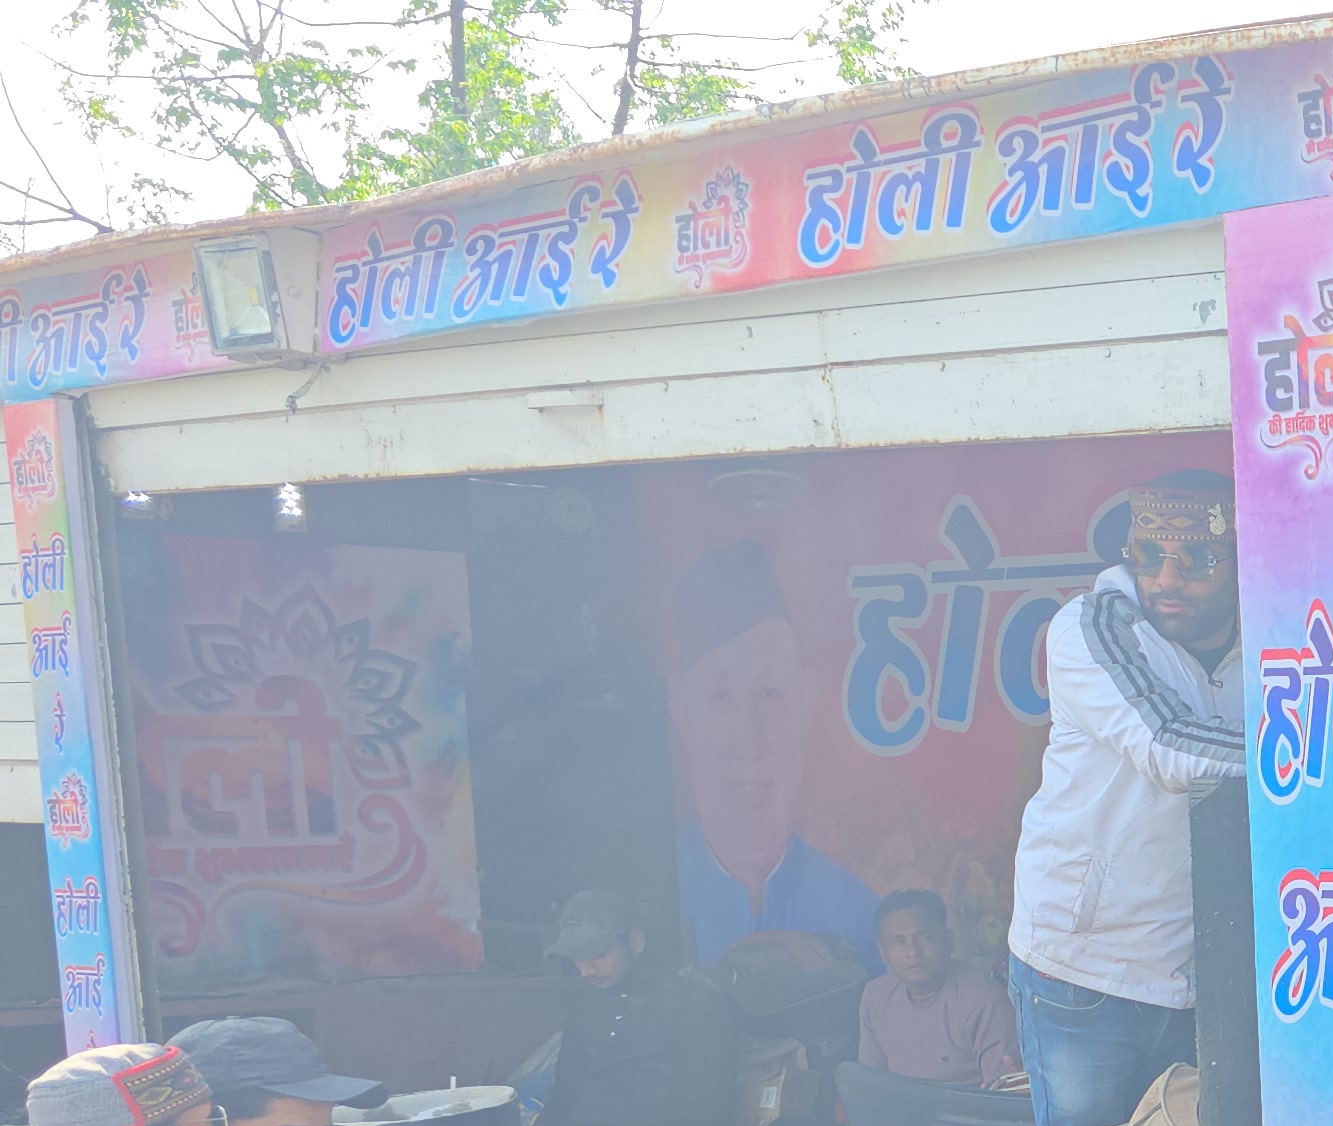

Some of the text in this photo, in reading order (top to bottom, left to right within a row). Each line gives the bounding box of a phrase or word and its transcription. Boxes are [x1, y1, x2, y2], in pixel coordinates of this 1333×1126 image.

[798, 53, 1234, 268] होली आई रे
[328, 167, 642, 347] होली आई रे
[675, 194, 733, 254] होली
[27, 267, 124, 390] आई
[119, 262, 152, 364] रे
[1268, 413, 1283, 436] की
[19, 531, 67, 600] होली
[30, 609, 72, 679] आई
[52, 691, 67, 754] रे
[47, 791, 81, 828] होली
[54, 874, 102, 937] होली
[64, 952, 106, 1019] आई
